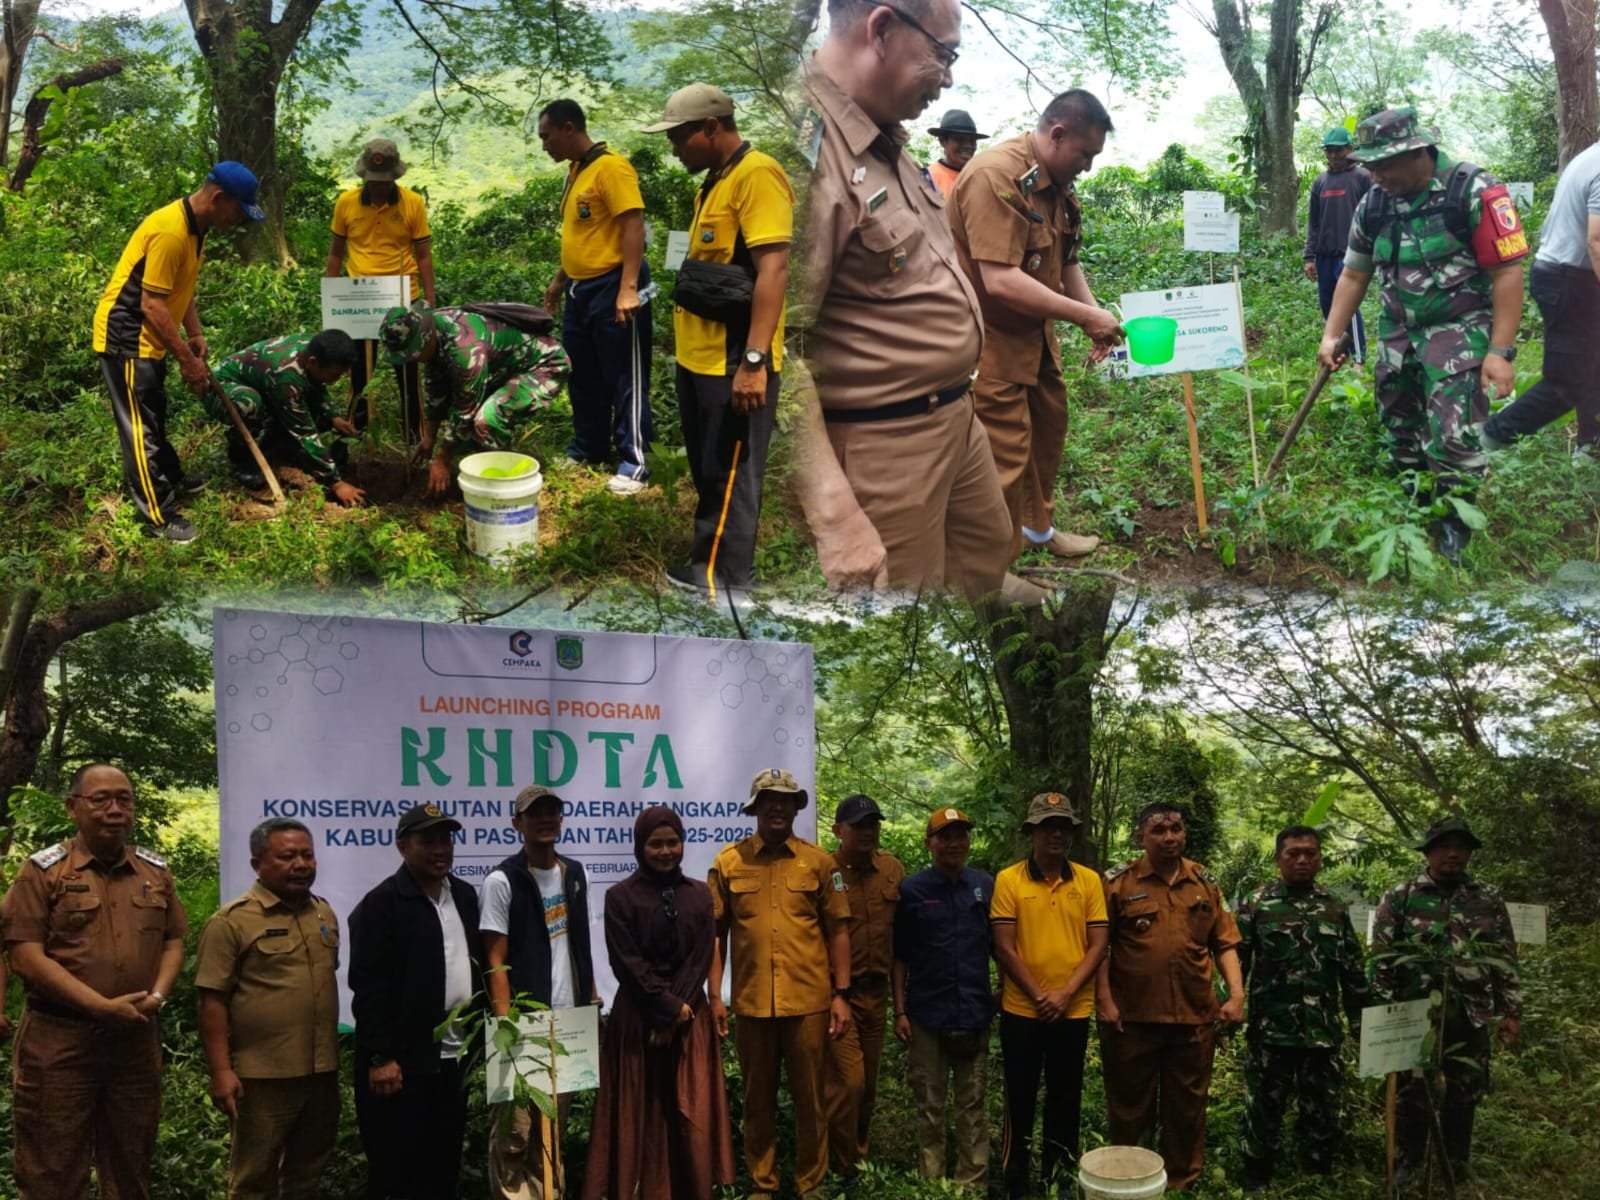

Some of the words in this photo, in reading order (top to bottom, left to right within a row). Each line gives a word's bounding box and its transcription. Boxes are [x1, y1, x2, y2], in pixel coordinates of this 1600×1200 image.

[1188, 325, 1228, 335] SUKORENO
[502, 657, 541, 667] CEMPAKA
[420, 695, 550, 716] LAUNCHING
[557, 700, 661, 720] PROGRAM
[401, 726, 684, 789] KHDTA
[560, 801, 643, 817] DAERAH
[326, 829, 466, 846] KABUN
[475, 827, 590, 845] PASAN
[682, 827, 753, 843] 25-2026
[586, 862, 637, 874] FEBRUAR
